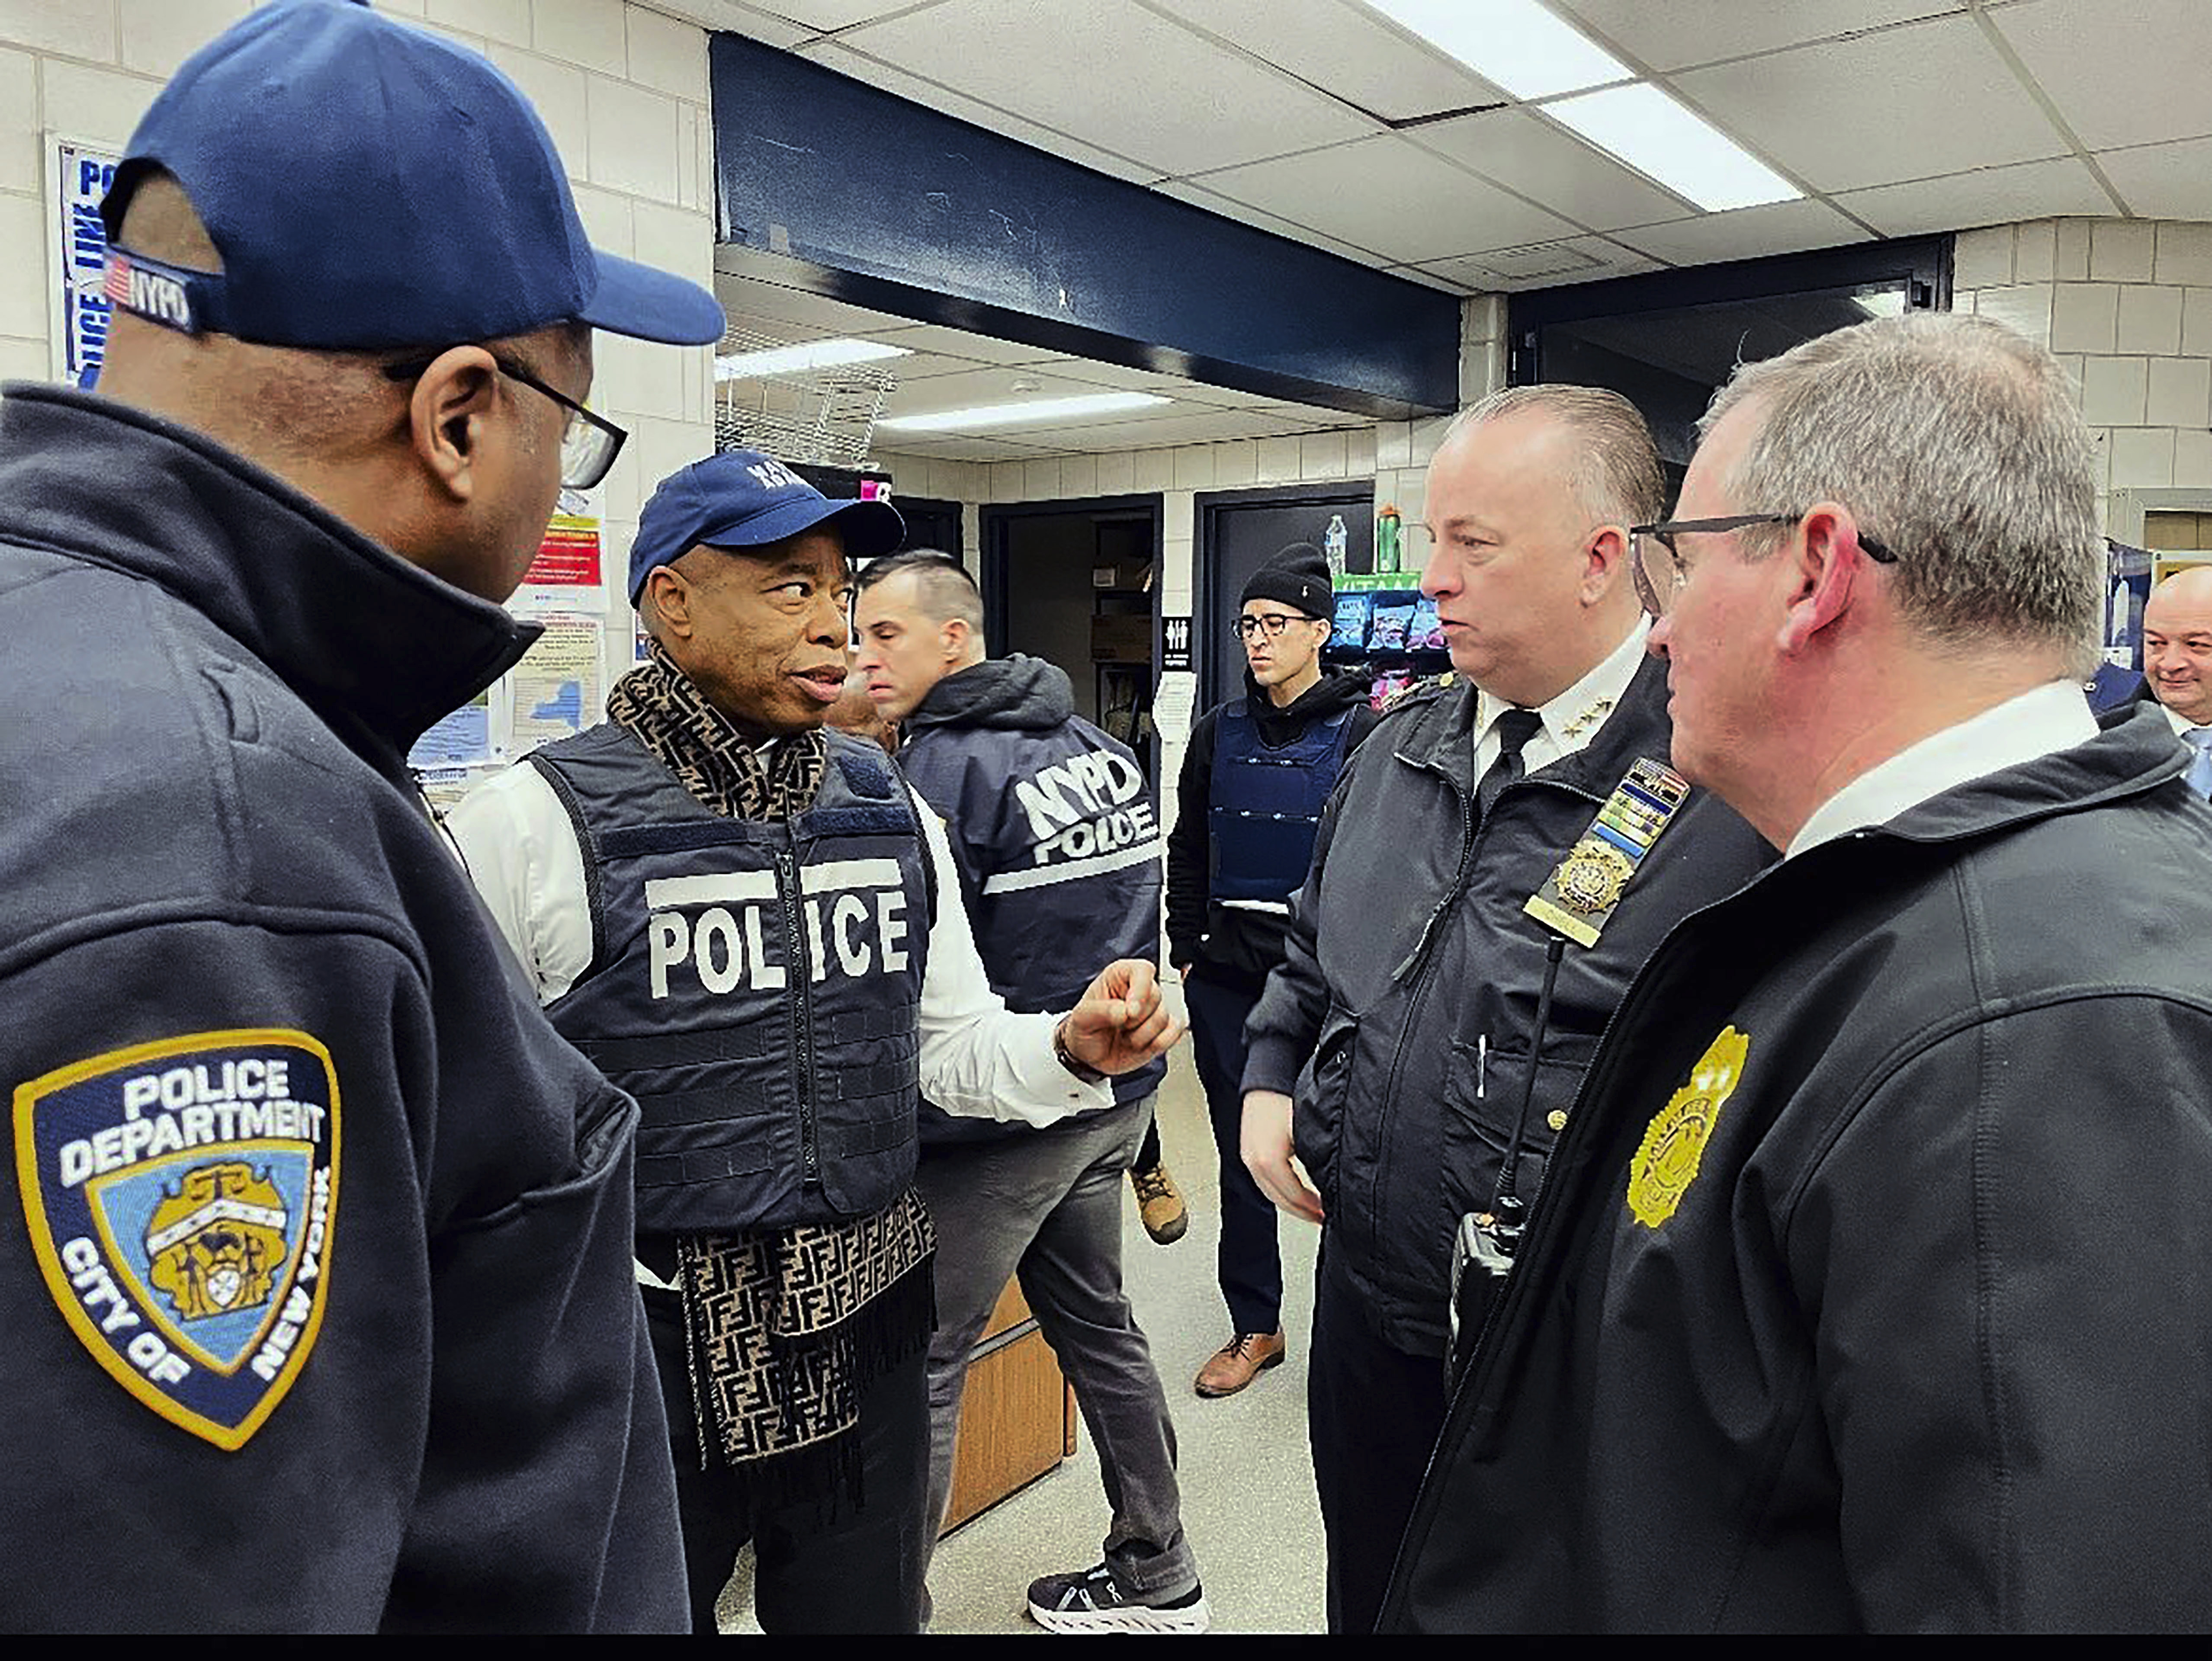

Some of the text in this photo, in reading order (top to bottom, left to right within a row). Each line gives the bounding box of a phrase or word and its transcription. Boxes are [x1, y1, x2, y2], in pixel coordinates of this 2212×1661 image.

[129, 268, 190, 326] NYPD
[1016, 750, 1141, 840] NYPD
[649, 890, 909, 1000] POLICE
[123, 1059, 289, 1121] POLICE
[60, 1099, 325, 1188] DEPARTMENT
[62, 1237, 192, 1385] CITY OF
[251, 1165, 331, 1381] NEW YORK
